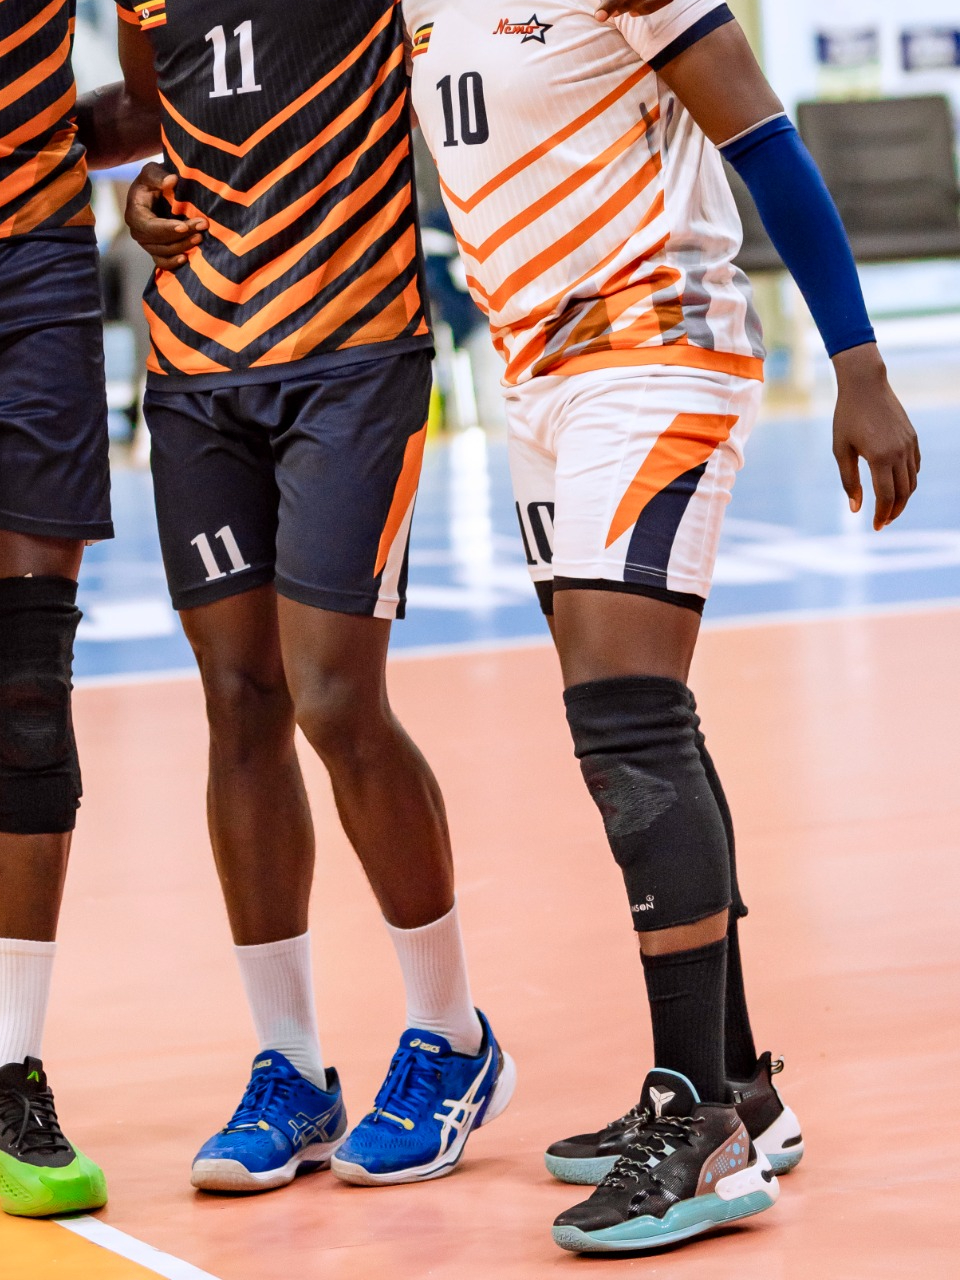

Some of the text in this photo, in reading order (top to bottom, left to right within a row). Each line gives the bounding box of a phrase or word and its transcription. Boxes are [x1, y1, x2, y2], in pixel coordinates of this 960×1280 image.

[204, 20, 262, 98] 11
[492, 18, 540, 35] Nemo
[436, 71, 490, 148] 10
[190, 525, 252, 582] 11
[515, 501, 555, 566] 10
